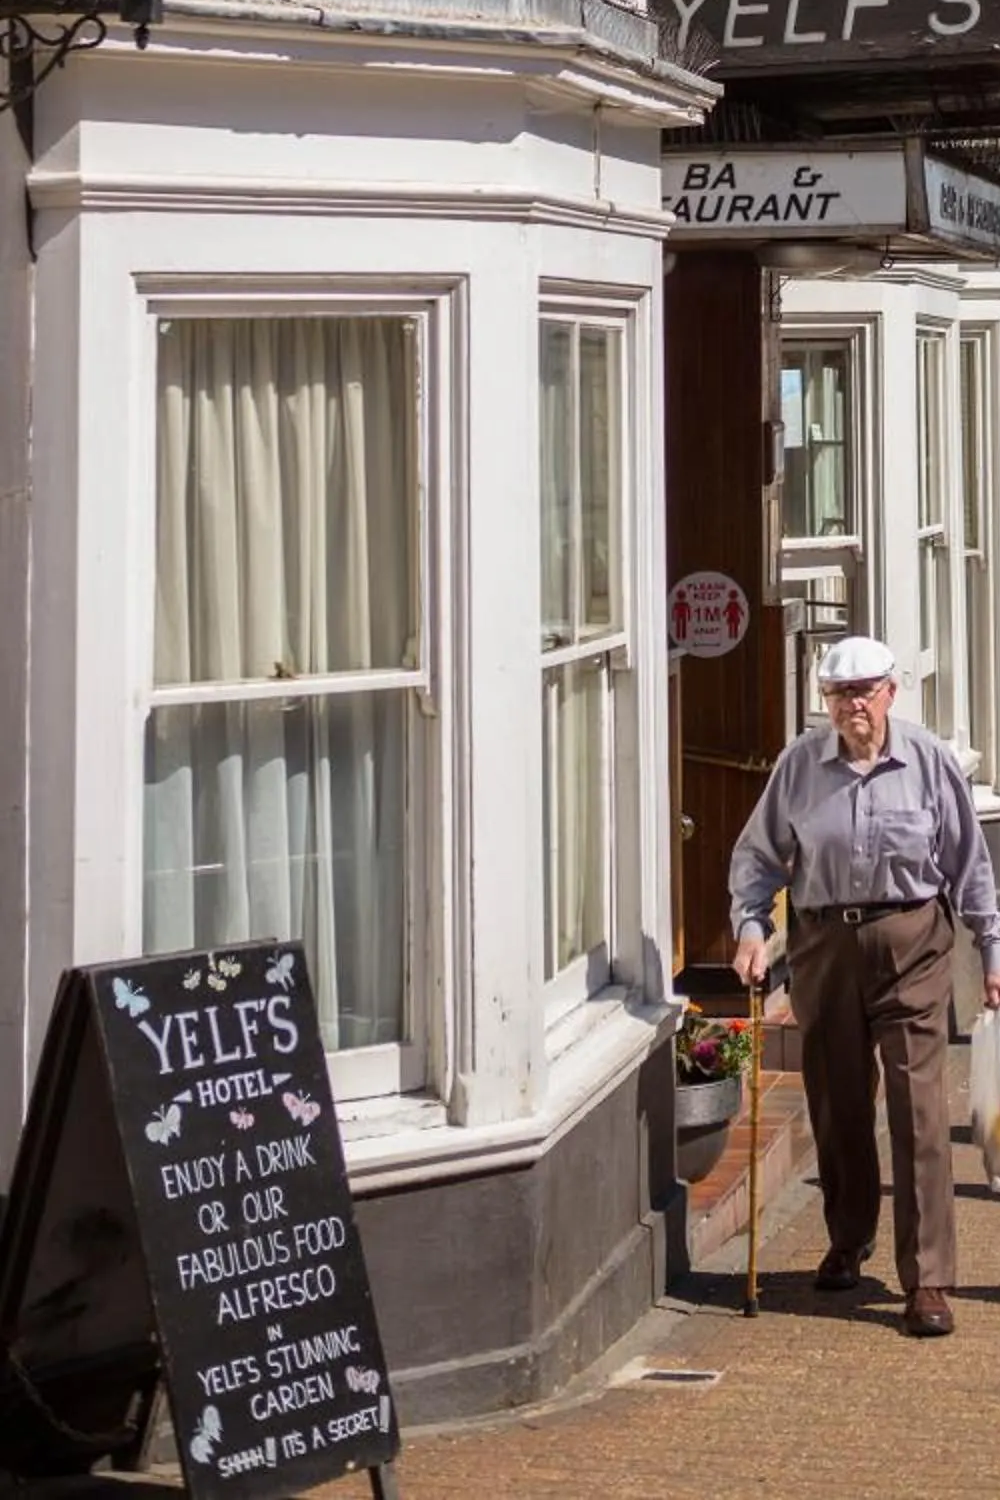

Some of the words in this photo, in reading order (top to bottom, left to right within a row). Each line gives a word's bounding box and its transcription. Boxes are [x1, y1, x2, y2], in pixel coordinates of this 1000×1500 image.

[793, 165, 823, 187] &
[137, 994, 299, 1076] YELF'S
[195, 1068, 274, 1108] HOTEL
[160, 1152, 226, 1200] ENJOY
[235, 1149, 253, 1184] A
[255, 1132, 318, 1178] DRINK
[198, 1201, 230, 1235] OR
[242, 1185, 289, 1224] OUR
[176, 1230, 292, 1292] FABULOUS
[293, 1216, 346, 1259] FOOD
[217, 1264, 336, 1327] ALFRESCO
[266, 1322, 284, 1343] IN
[266, 1326, 362, 1380] STUNNING
[250, 1371, 336, 1421] GARDEN
[311, 1425, 328, 1450] A
